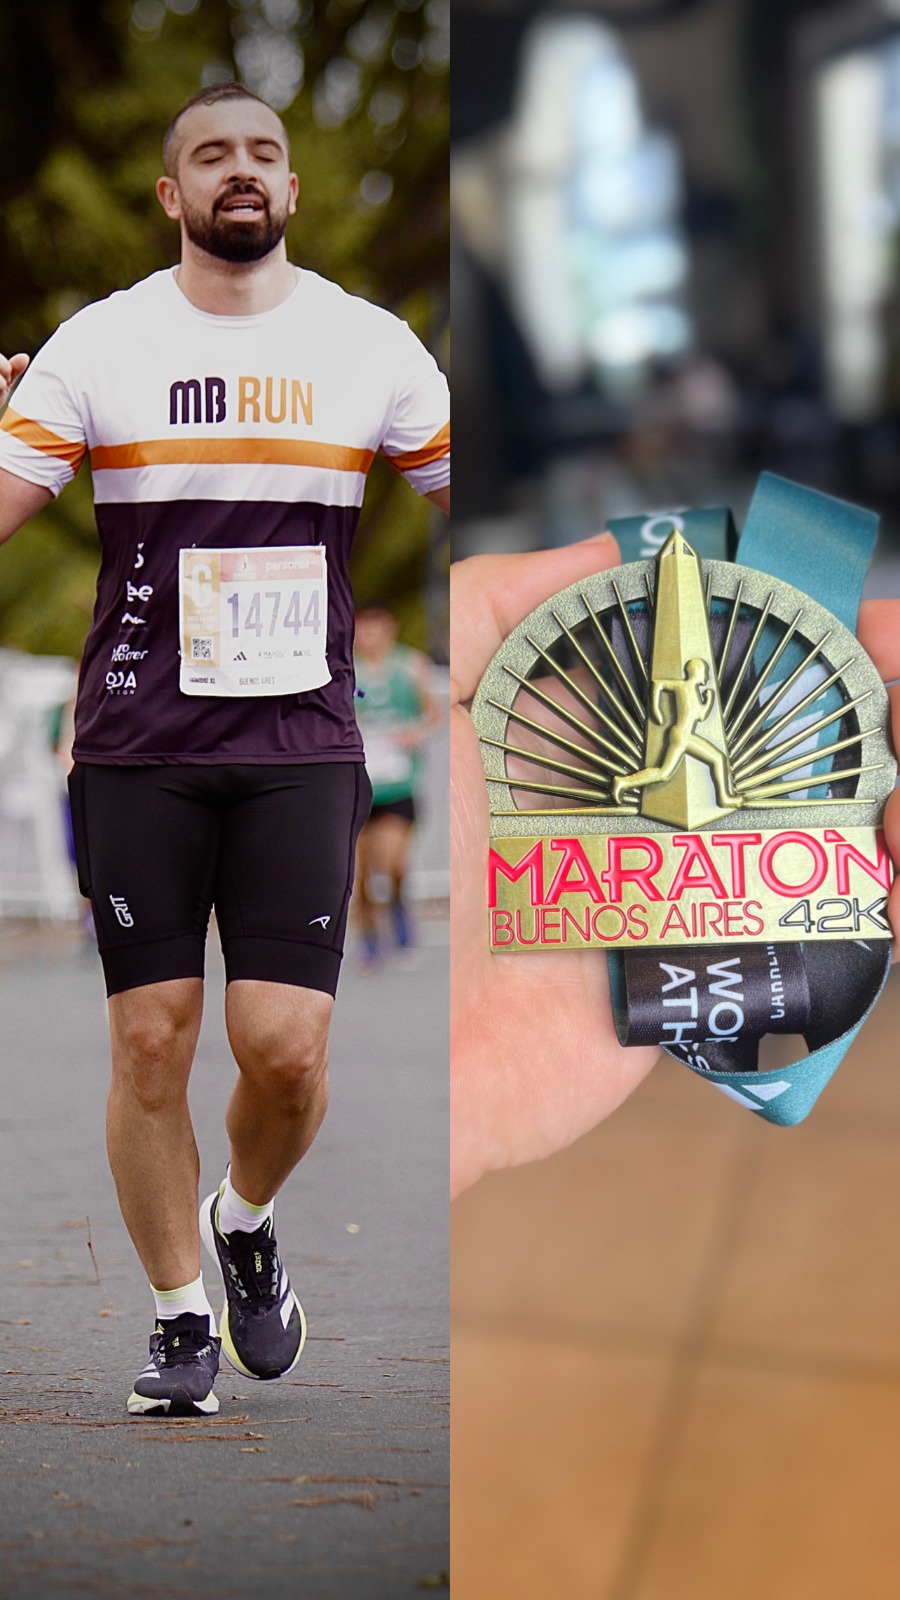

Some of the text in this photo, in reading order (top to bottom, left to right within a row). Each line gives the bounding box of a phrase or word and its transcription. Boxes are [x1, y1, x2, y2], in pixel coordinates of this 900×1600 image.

[169, 376, 313, 426] MB RUN
[191, 563, 213, 608] C
[265, 558, 309, 573] personal
[227, 590, 321, 638] 14744
[109, 894, 134, 928] GRIT
[491, 896, 890, 946] BUENOS AIRES 42K
